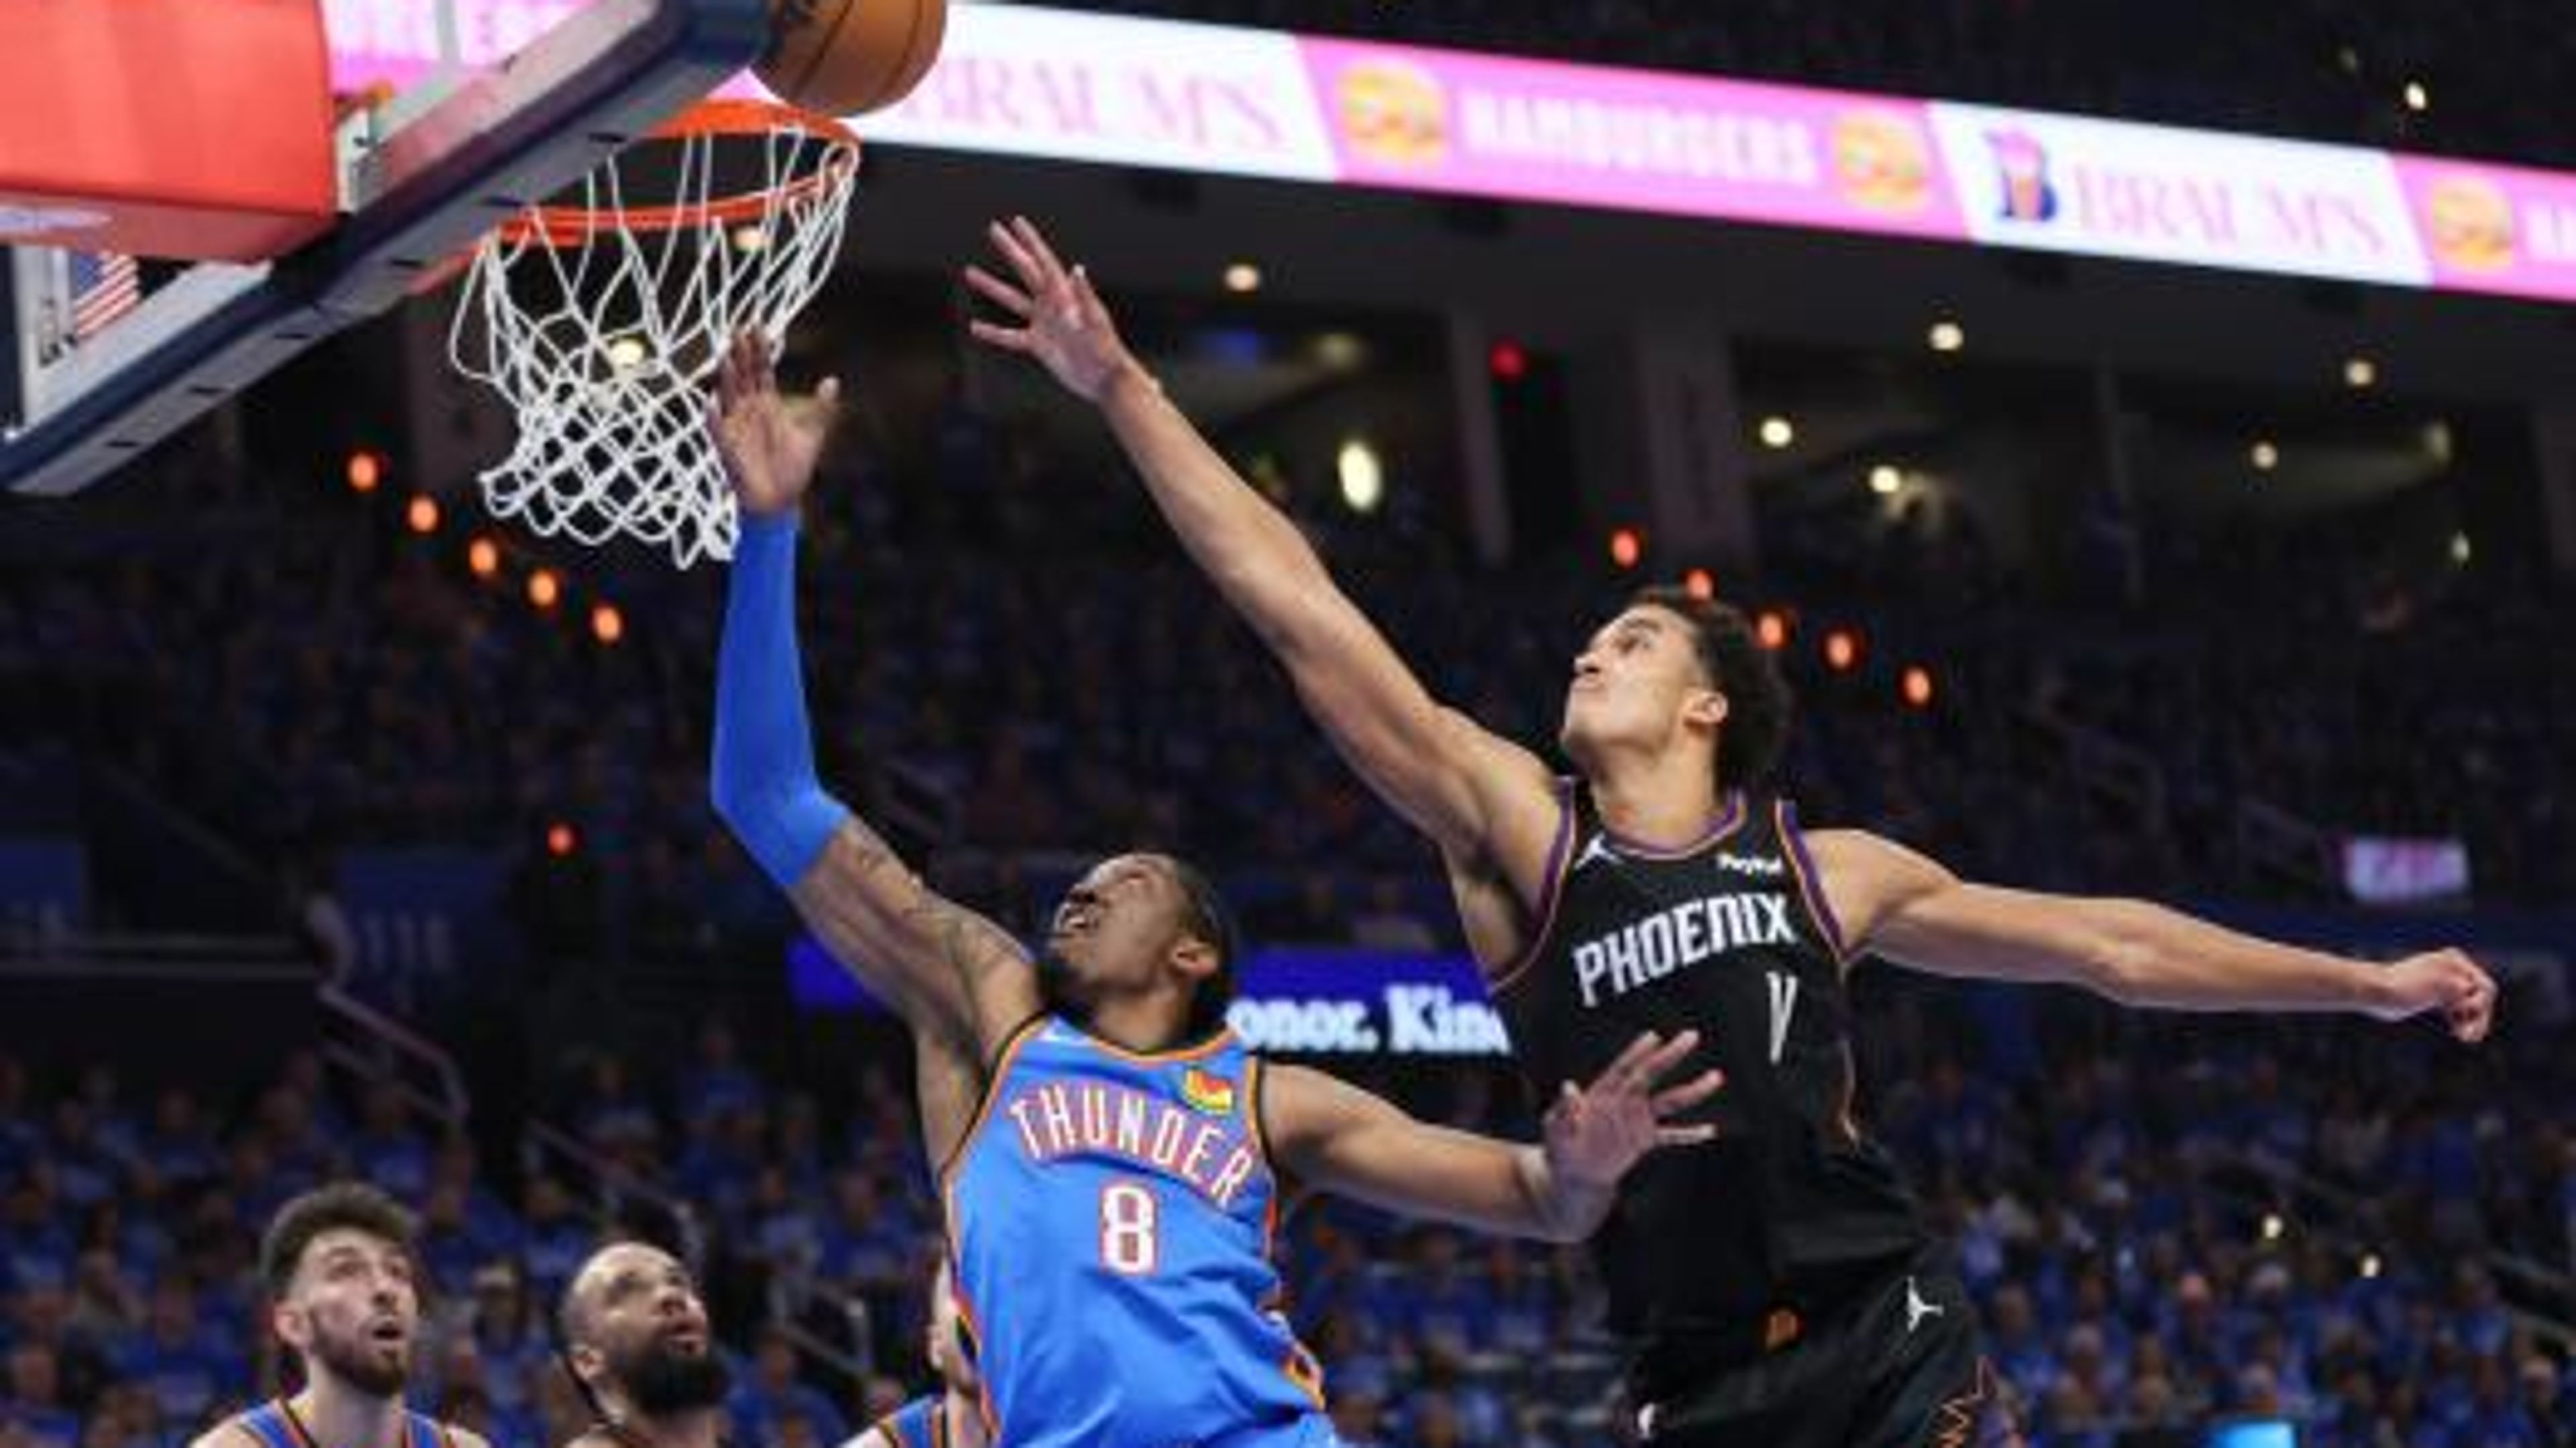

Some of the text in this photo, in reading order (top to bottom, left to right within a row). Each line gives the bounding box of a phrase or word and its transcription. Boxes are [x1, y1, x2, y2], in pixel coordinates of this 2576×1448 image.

[1461, 94, 1817, 187] HAMBURGERS
[2070, 165, 2386, 258] BRAUM'S
[1573, 892, 1796, 1007] PHOENIX
[1226, 998, 1379, 1052] onor.
[1009, 1081, 1254, 1210] THUNDER
[1100, 1180, 1158, 1276] 8
